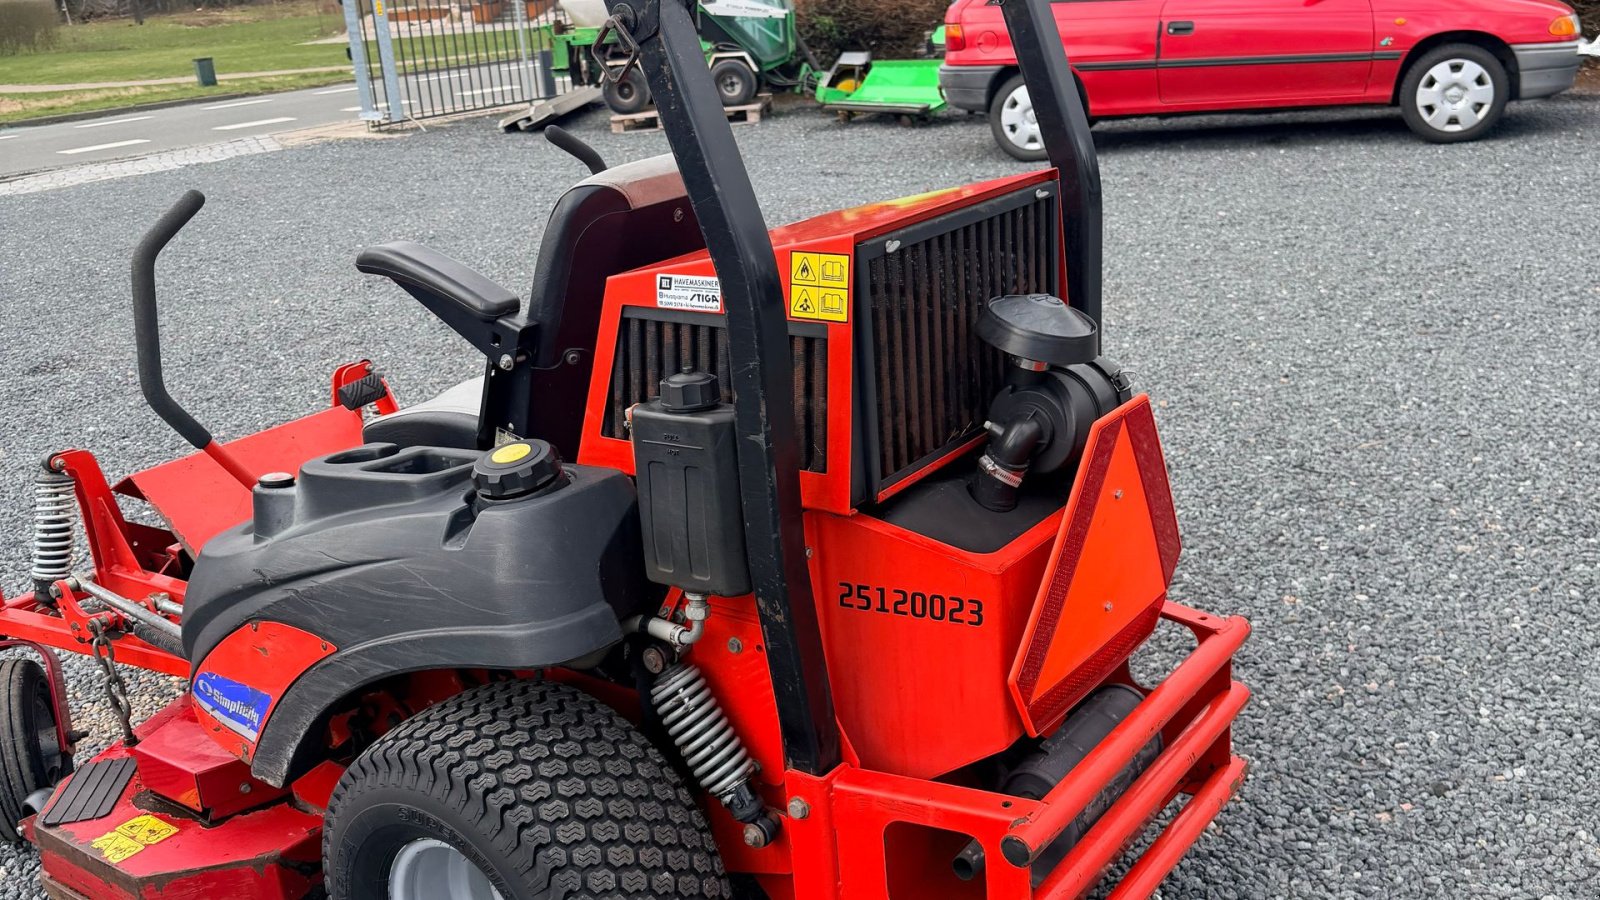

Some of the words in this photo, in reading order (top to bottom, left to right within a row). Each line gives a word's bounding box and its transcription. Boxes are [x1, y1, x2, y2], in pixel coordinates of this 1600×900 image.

[674, 278, 719, 287] HAVEMASKINER
[690, 293, 719, 303] STIGA
[839, 582, 984, 626] 25120023
[213, 688, 260, 728] Simplicity
[398, 806, 466, 850] SUPER
